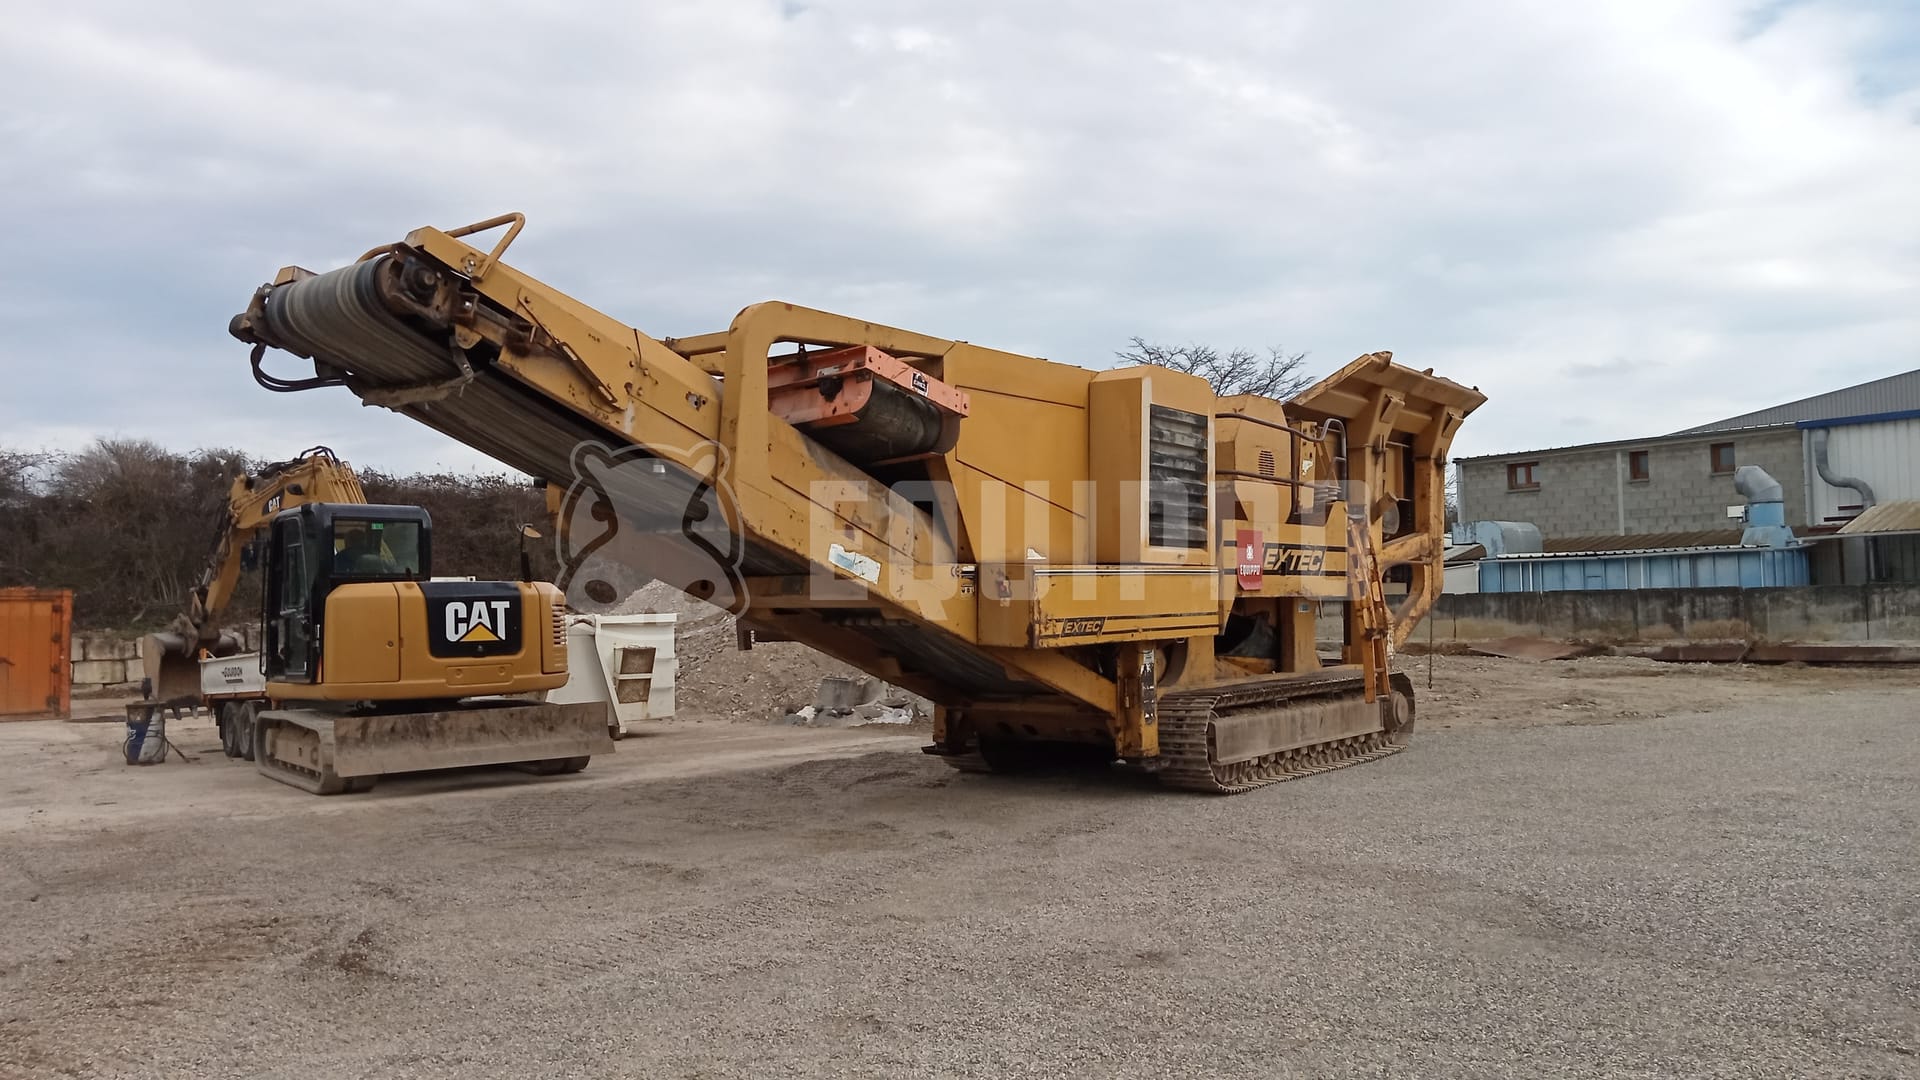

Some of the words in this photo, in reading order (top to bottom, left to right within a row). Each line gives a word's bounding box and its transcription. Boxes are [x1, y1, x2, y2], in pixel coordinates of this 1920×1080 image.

[1263, 548, 1323, 571] EXTEC
[445, 601, 510, 642] CAT
[1064, 620, 1102, 634] EXTEC
